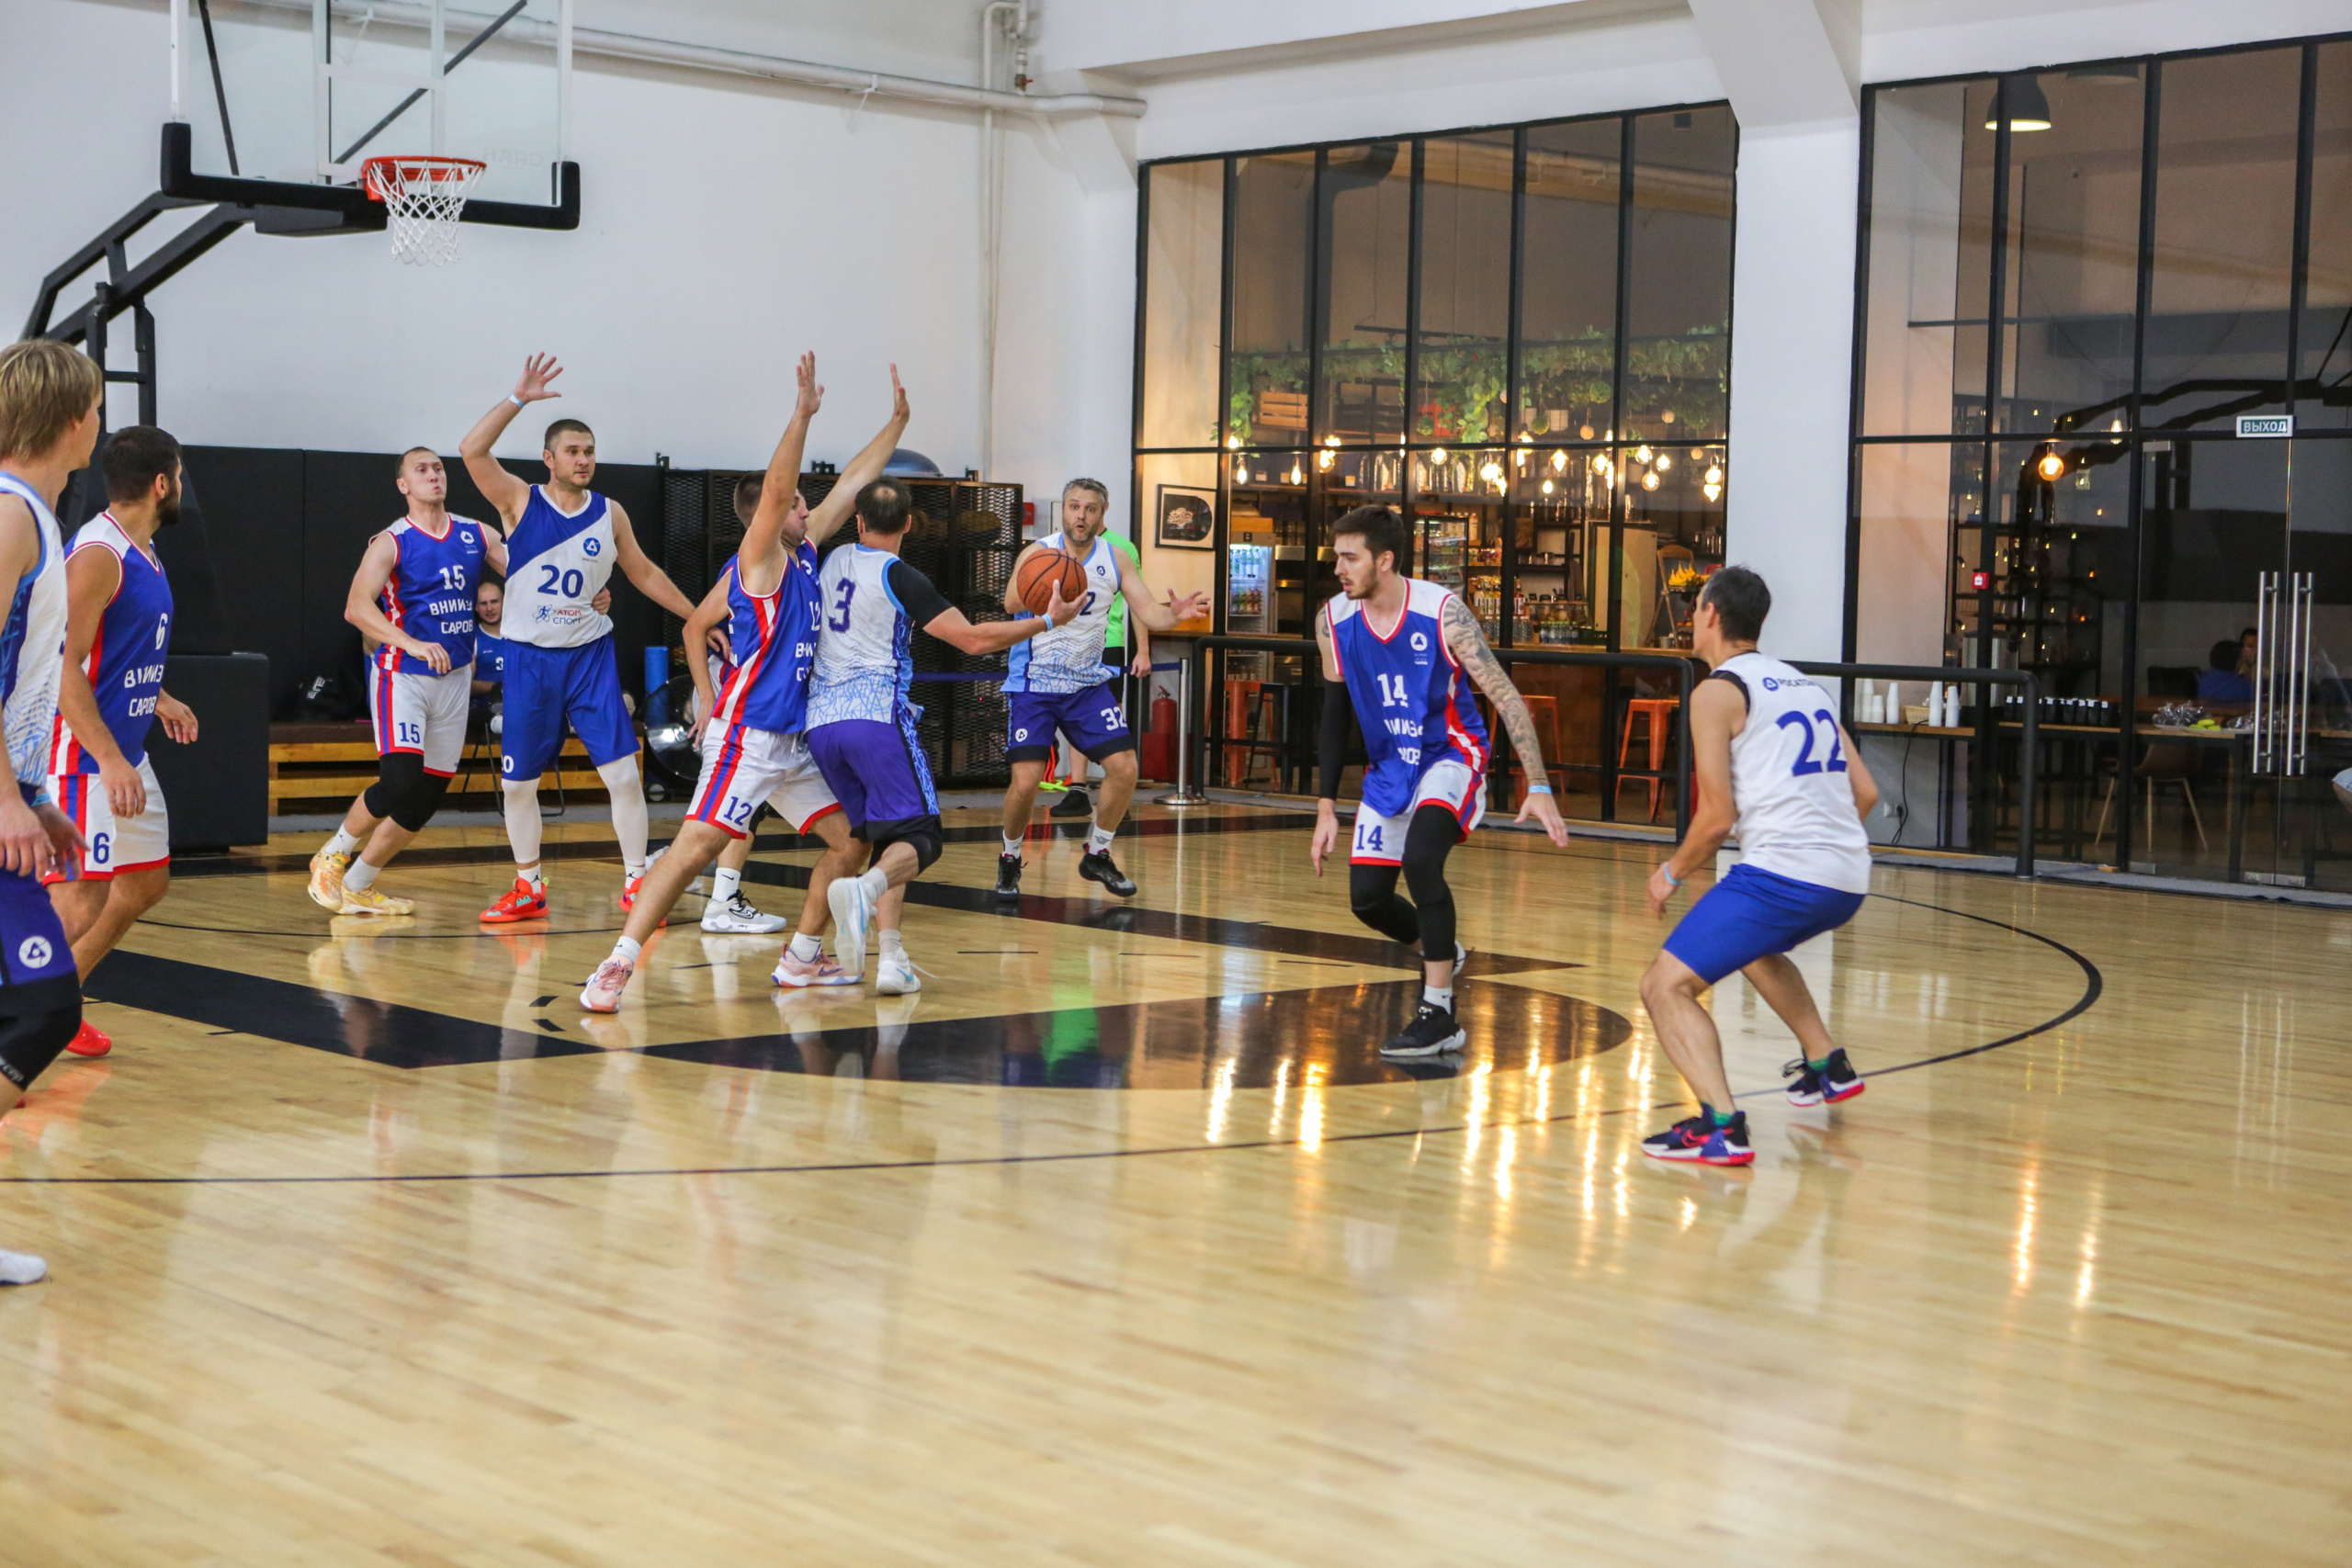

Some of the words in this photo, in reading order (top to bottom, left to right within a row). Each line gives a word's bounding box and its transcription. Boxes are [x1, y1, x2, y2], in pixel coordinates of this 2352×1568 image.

[2244, 421, 2287, 433] ВЫХОД
[439, 564, 466, 591] 15
[537, 564, 583, 599] 20
[809, 601, 820, 631] 12
[828, 577, 856, 634] 3
[155, 613, 168, 650] 6
[441, 620, 473, 634] САРОВ
[553, 617, 582, 626] СПОРТ
[1377, 673, 1408, 707] 14
[129, 696, 157, 716] САРОВ
[1101, 706, 1127, 731] 32
[399, 722, 421, 744] 15
[1775, 709, 1847, 777] 22
[502, 755, 514, 773] 0
[723, 796, 752, 826] 12
[94, 832, 109, 864] 6
[1356, 824, 1383, 852] 14
